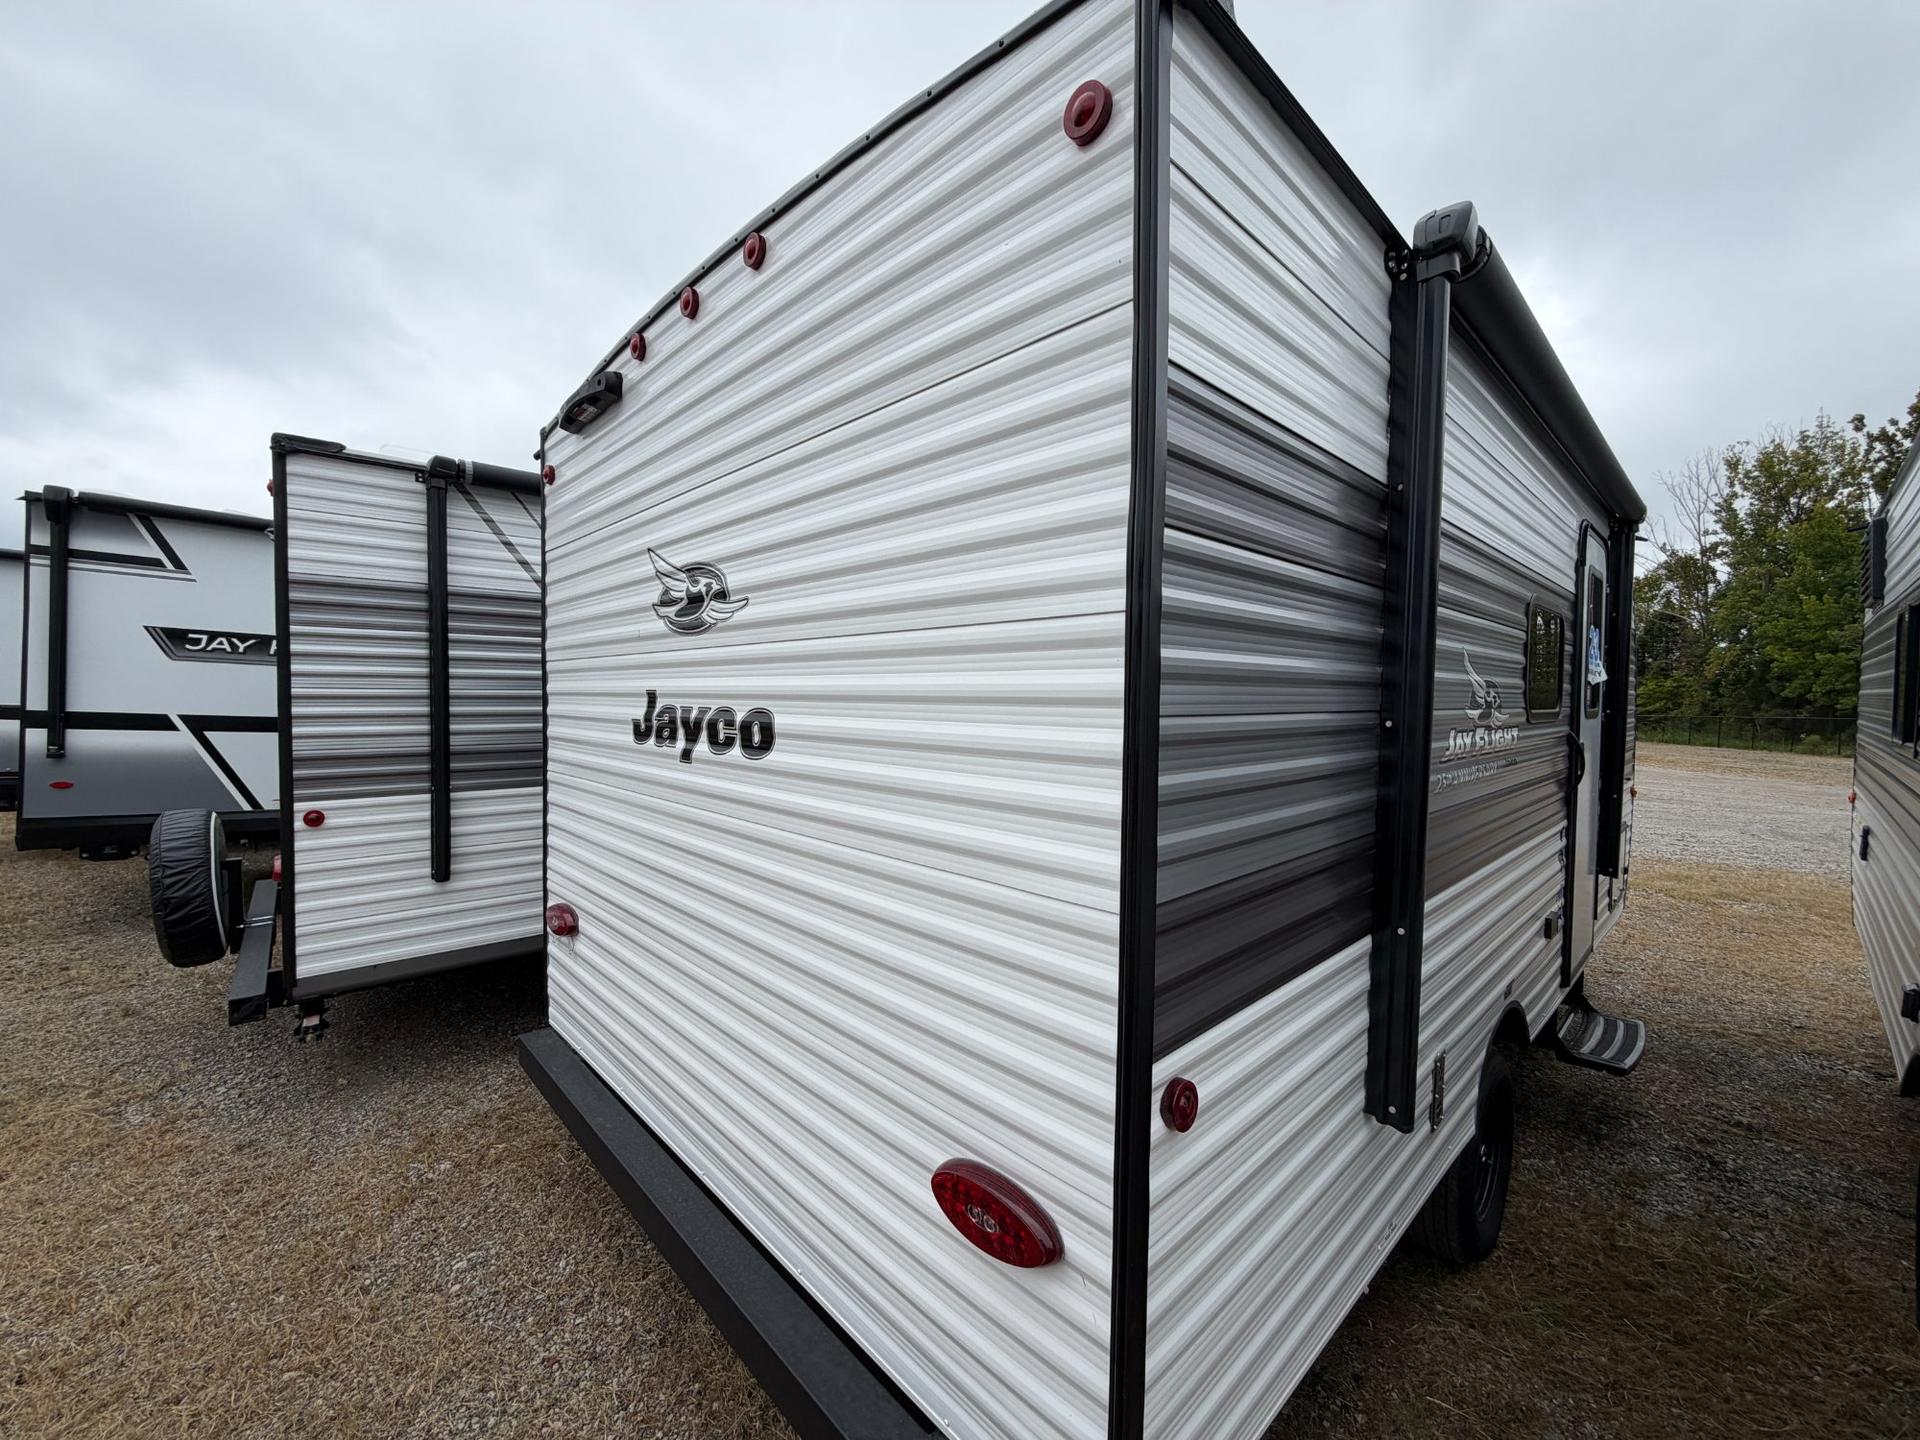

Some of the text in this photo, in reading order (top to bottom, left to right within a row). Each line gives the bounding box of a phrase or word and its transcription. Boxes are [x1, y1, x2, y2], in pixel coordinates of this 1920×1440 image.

[184, 633, 261, 654] JAY
[632, 689, 776, 764] Jayco
[1443, 725, 1519, 757] JAY FLIGHT
